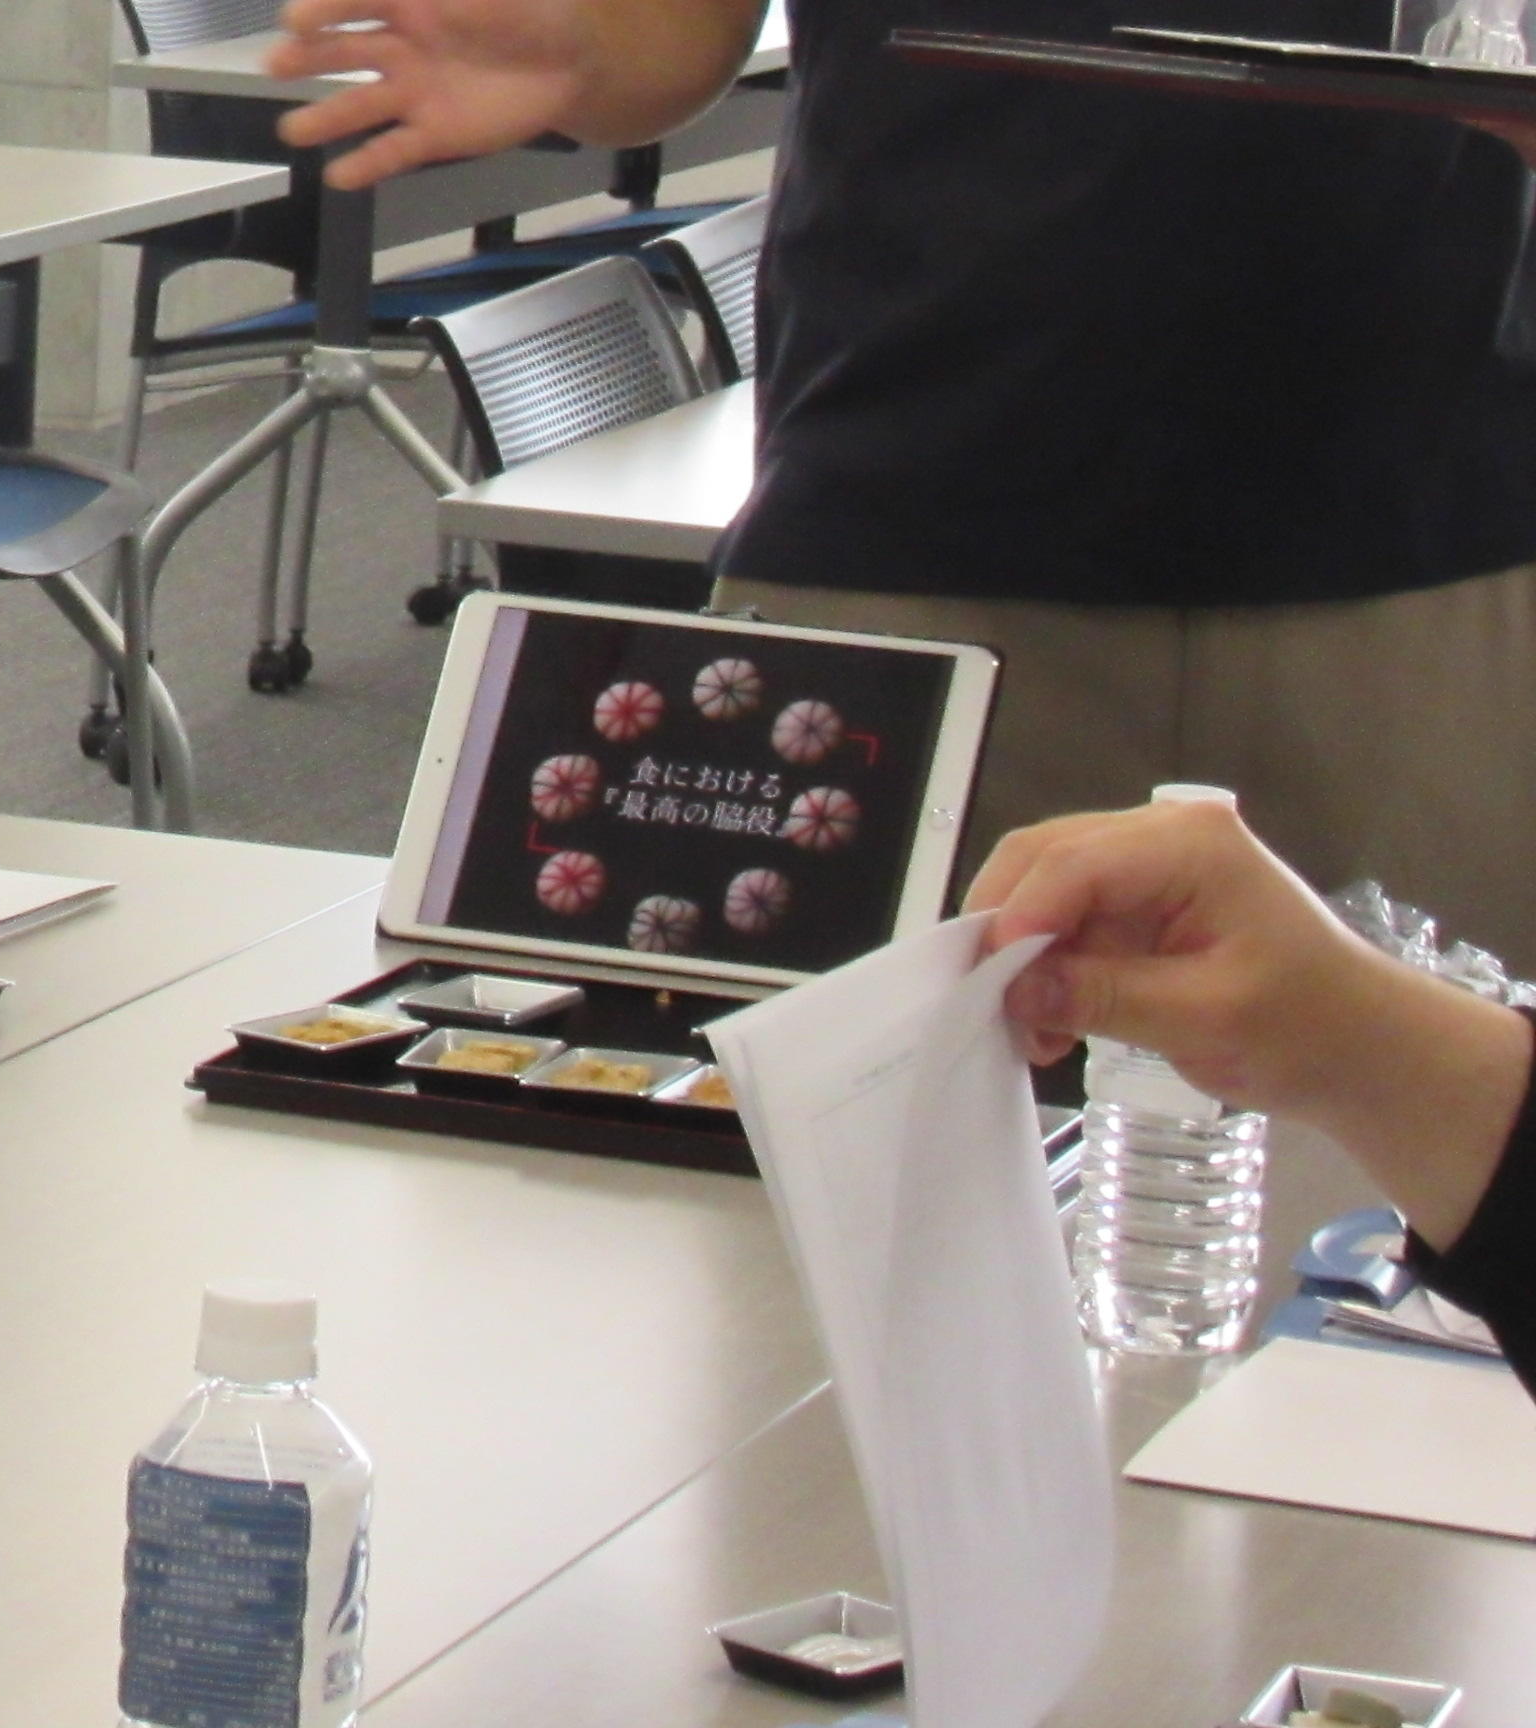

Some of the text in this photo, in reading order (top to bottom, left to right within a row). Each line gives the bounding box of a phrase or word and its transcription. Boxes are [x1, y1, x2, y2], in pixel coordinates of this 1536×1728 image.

[629, 755, 781, 799] 食における
